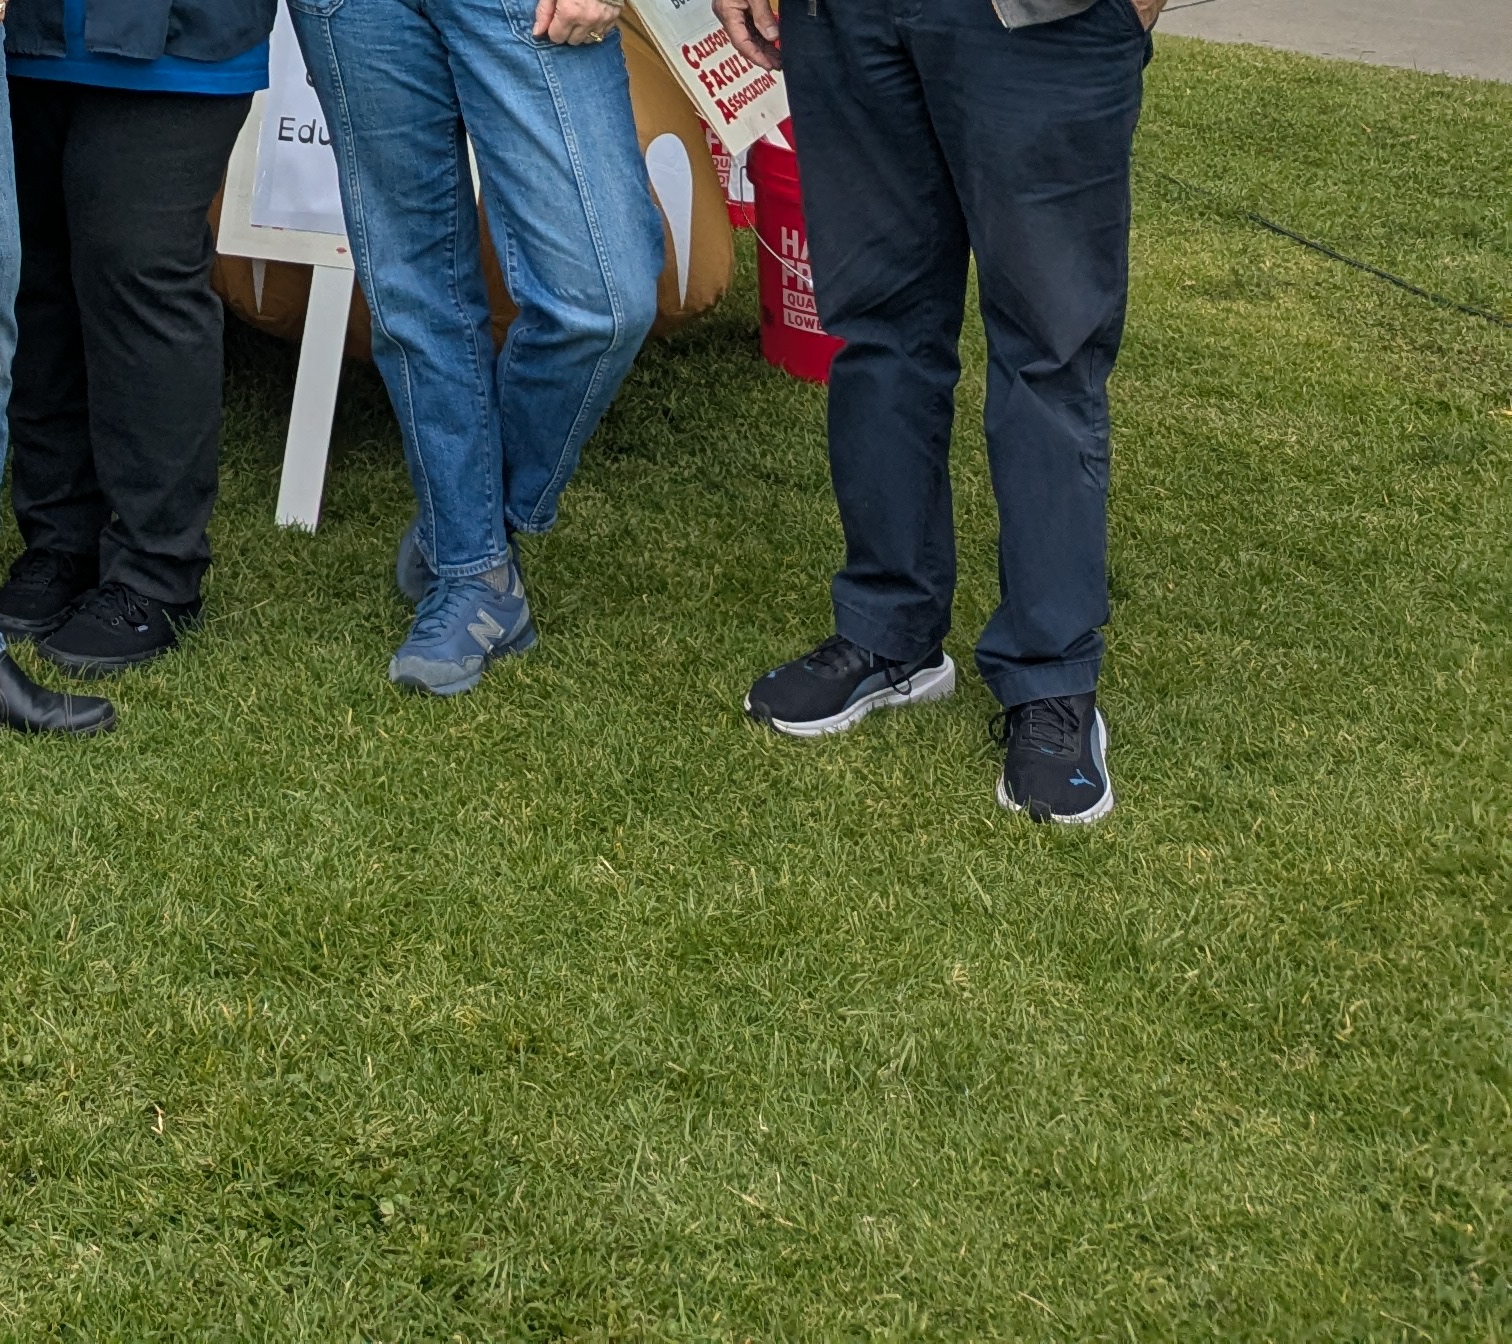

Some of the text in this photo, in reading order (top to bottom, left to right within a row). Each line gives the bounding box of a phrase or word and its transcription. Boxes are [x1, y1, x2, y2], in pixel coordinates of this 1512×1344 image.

[682, 28, 731, 70] CALIFOR
[698, 53, 753, 98] FACUL
[715, 72, 777, 125] ASSOCIATION
[277, 116, 332, 146] Edu
